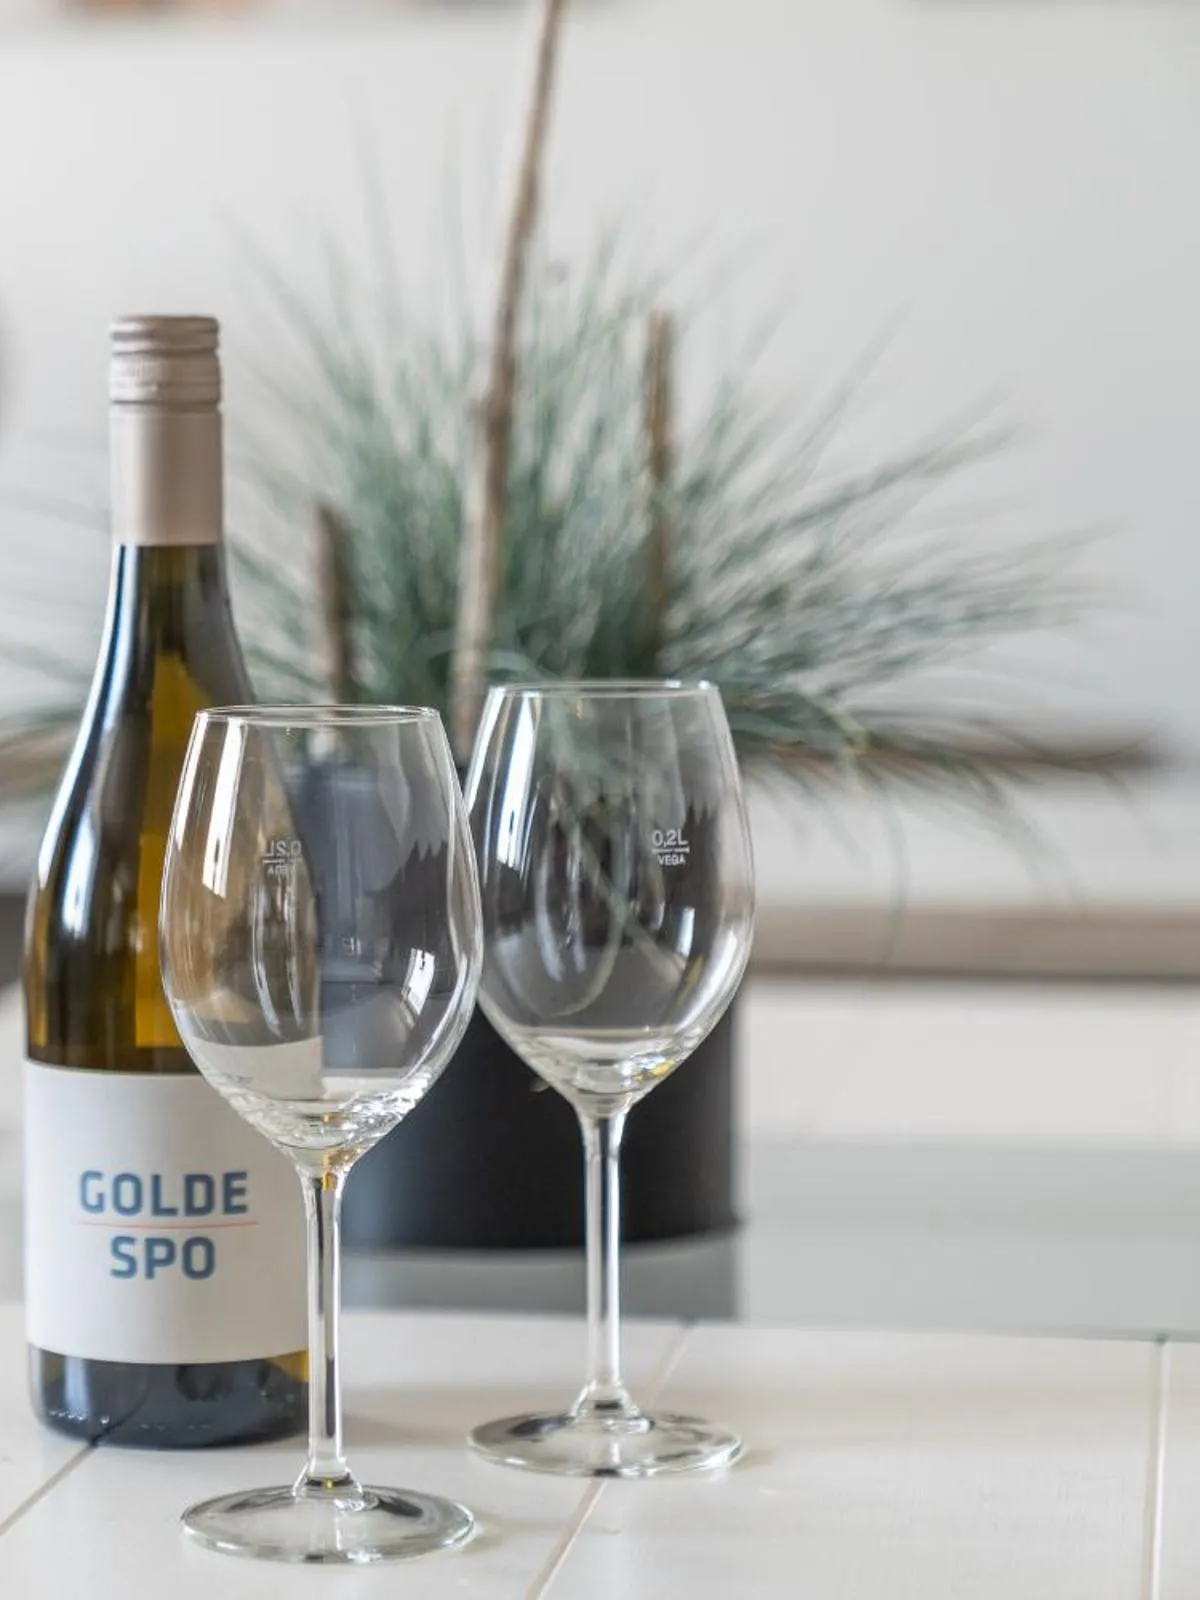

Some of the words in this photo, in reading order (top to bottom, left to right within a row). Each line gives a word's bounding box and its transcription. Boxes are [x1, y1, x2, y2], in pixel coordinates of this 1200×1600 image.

[652, 828, 688, 847] 0,2L
[657, 854, 686, 866] VEGA
[80, 1170, 248, 1217] GOLDE
[110, 1235, 215, 1280] SPO
